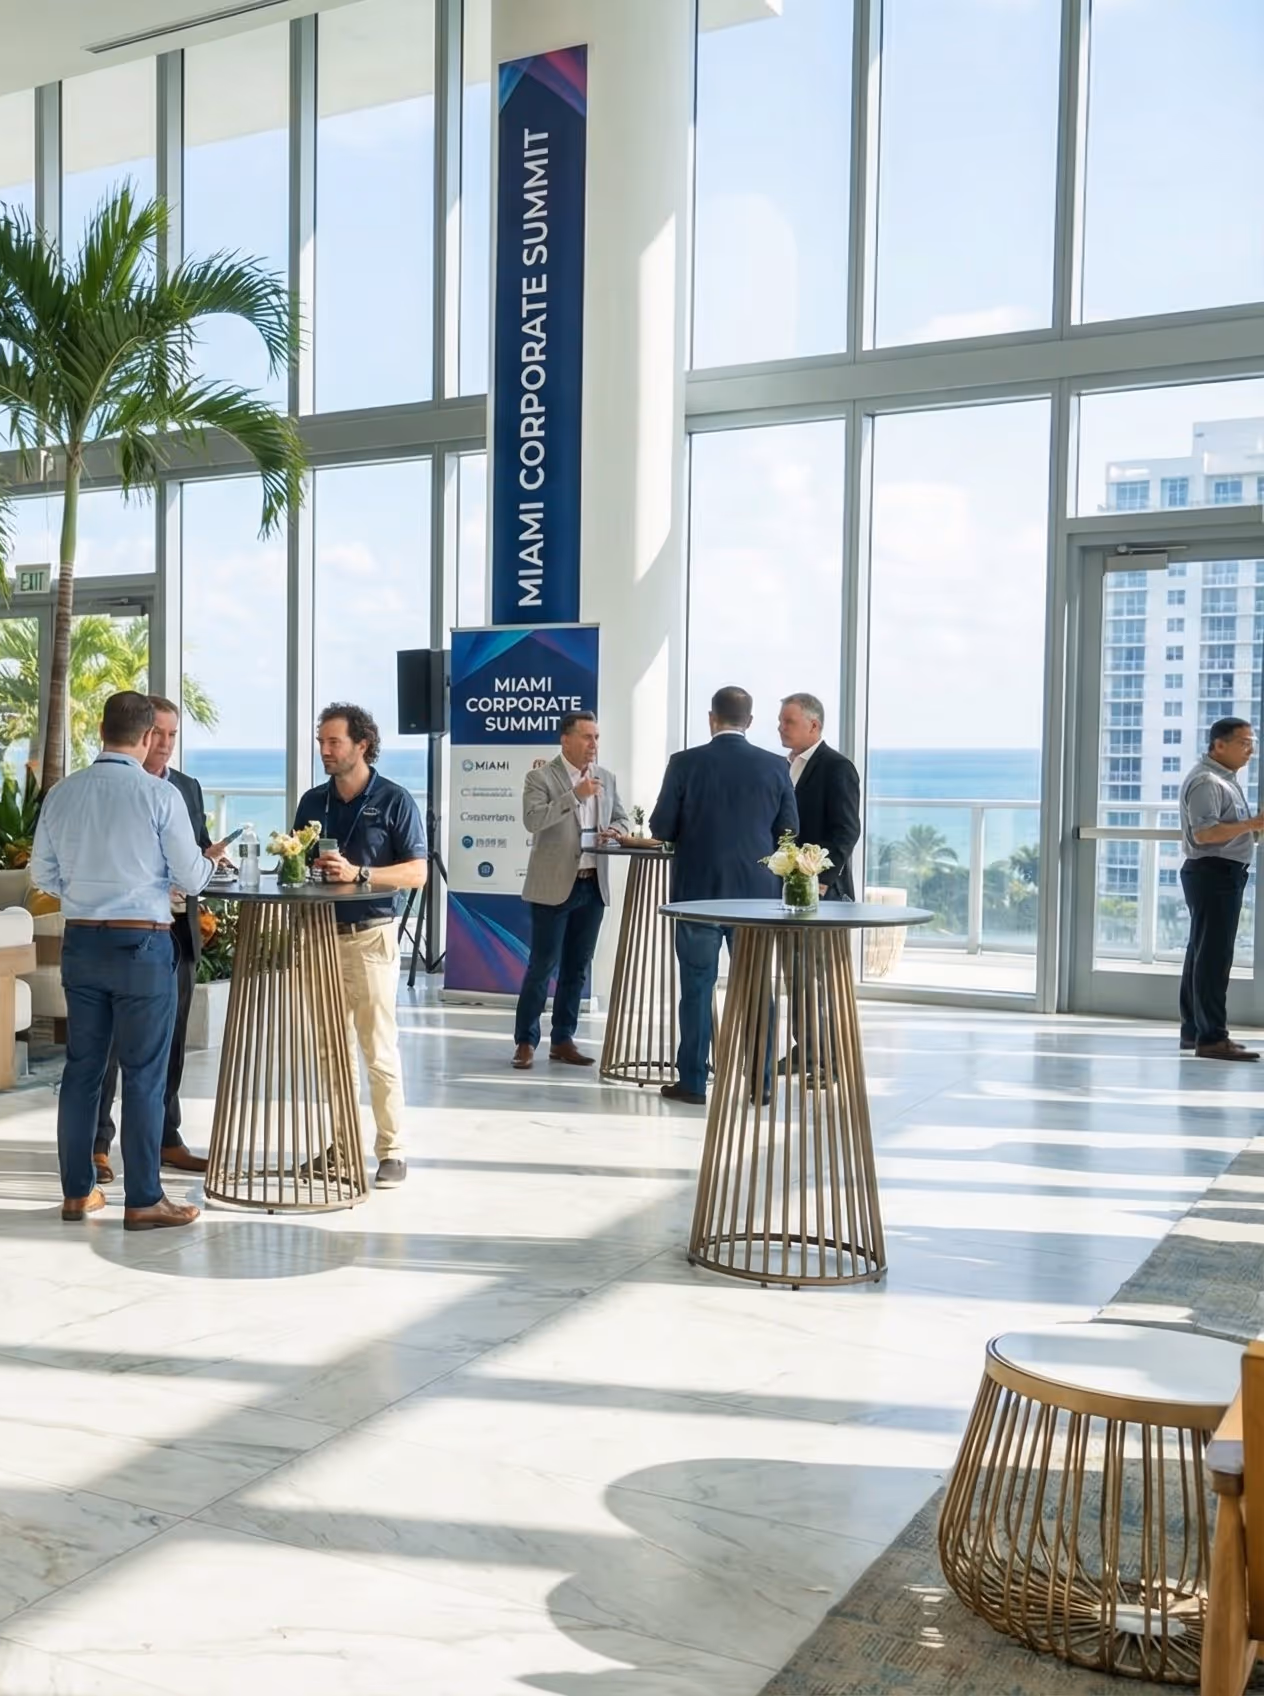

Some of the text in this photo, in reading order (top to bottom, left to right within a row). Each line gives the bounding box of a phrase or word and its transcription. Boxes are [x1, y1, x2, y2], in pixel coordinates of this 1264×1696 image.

[518, 128, 549, 607] MIAMI CORPORATE SUMMIT
[20, 572, 45, 591] EXIT
[494, 676, 552, 692] MIAMI
[465, 696, 582, 712] CORPORATE
[484, 716, 561, 732] SUMMIT
[475, 761, 510, 771] MIAMI
